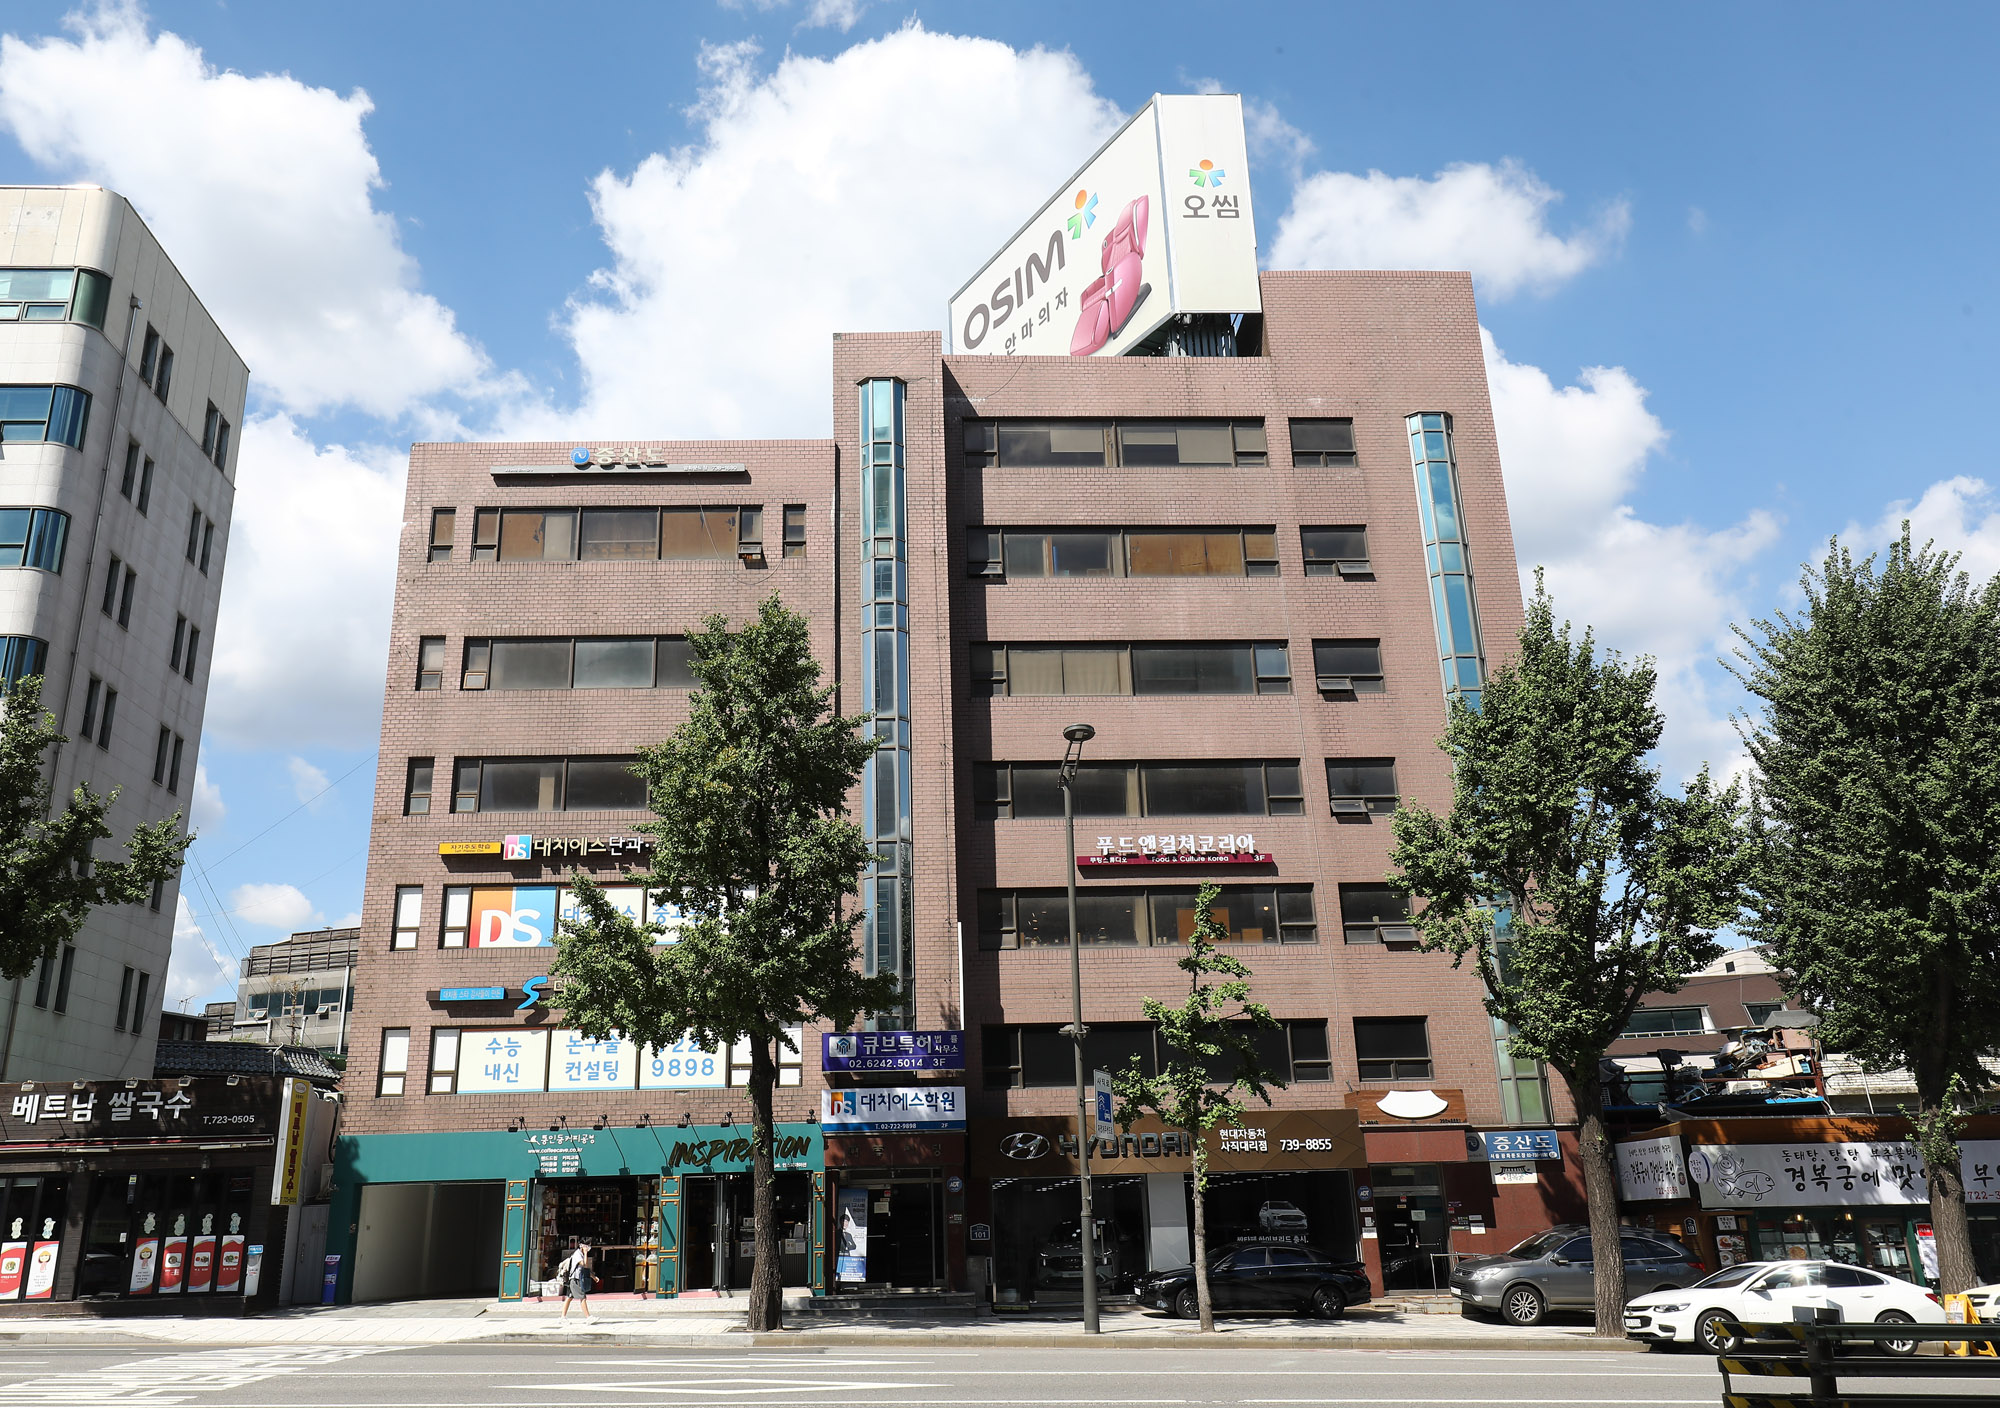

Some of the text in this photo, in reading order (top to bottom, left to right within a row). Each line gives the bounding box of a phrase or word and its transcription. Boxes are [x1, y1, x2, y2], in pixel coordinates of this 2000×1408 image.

[1182, 194, 1240, 219] 오씸
[963, 229, 1067, 350] OSIM
[593, 447, 665, 465] 증산도
[1179, 855, 1206, 863] Culture
[478, 907, 544, 948] DS
[485, 1037, 522, 1057] 수능
[863, 1035, 932, 1055] 큐브특허
[934, 1044, 959, 1053] 사무소
[565, 1061, 619, 1082] 컨설팅
[651, 1058, 715, 1077] 9898
[849, 1058, 946, 1068] 02.6242.5014 3F
[484, 1063, 520, 1083] 내신
[12, 1090, 192, 1124] 베트남 쌀국수
[860, 1091, 956, 1113] 대치에스학원
[203, 1115, 255, 1125] T.723-0505
[1219, 1128, 1267, 1139] 현대자동차
[1492, 1134, 1553, 1151] 증산도
[1220, 1140, 1268, 1152] 사직대리점
[1279, 1138, 1333, 1151] 739-8855
[1785, 1164, 1881, 1193] 경복궁에
[974, 1231, 987, 1239] 101
